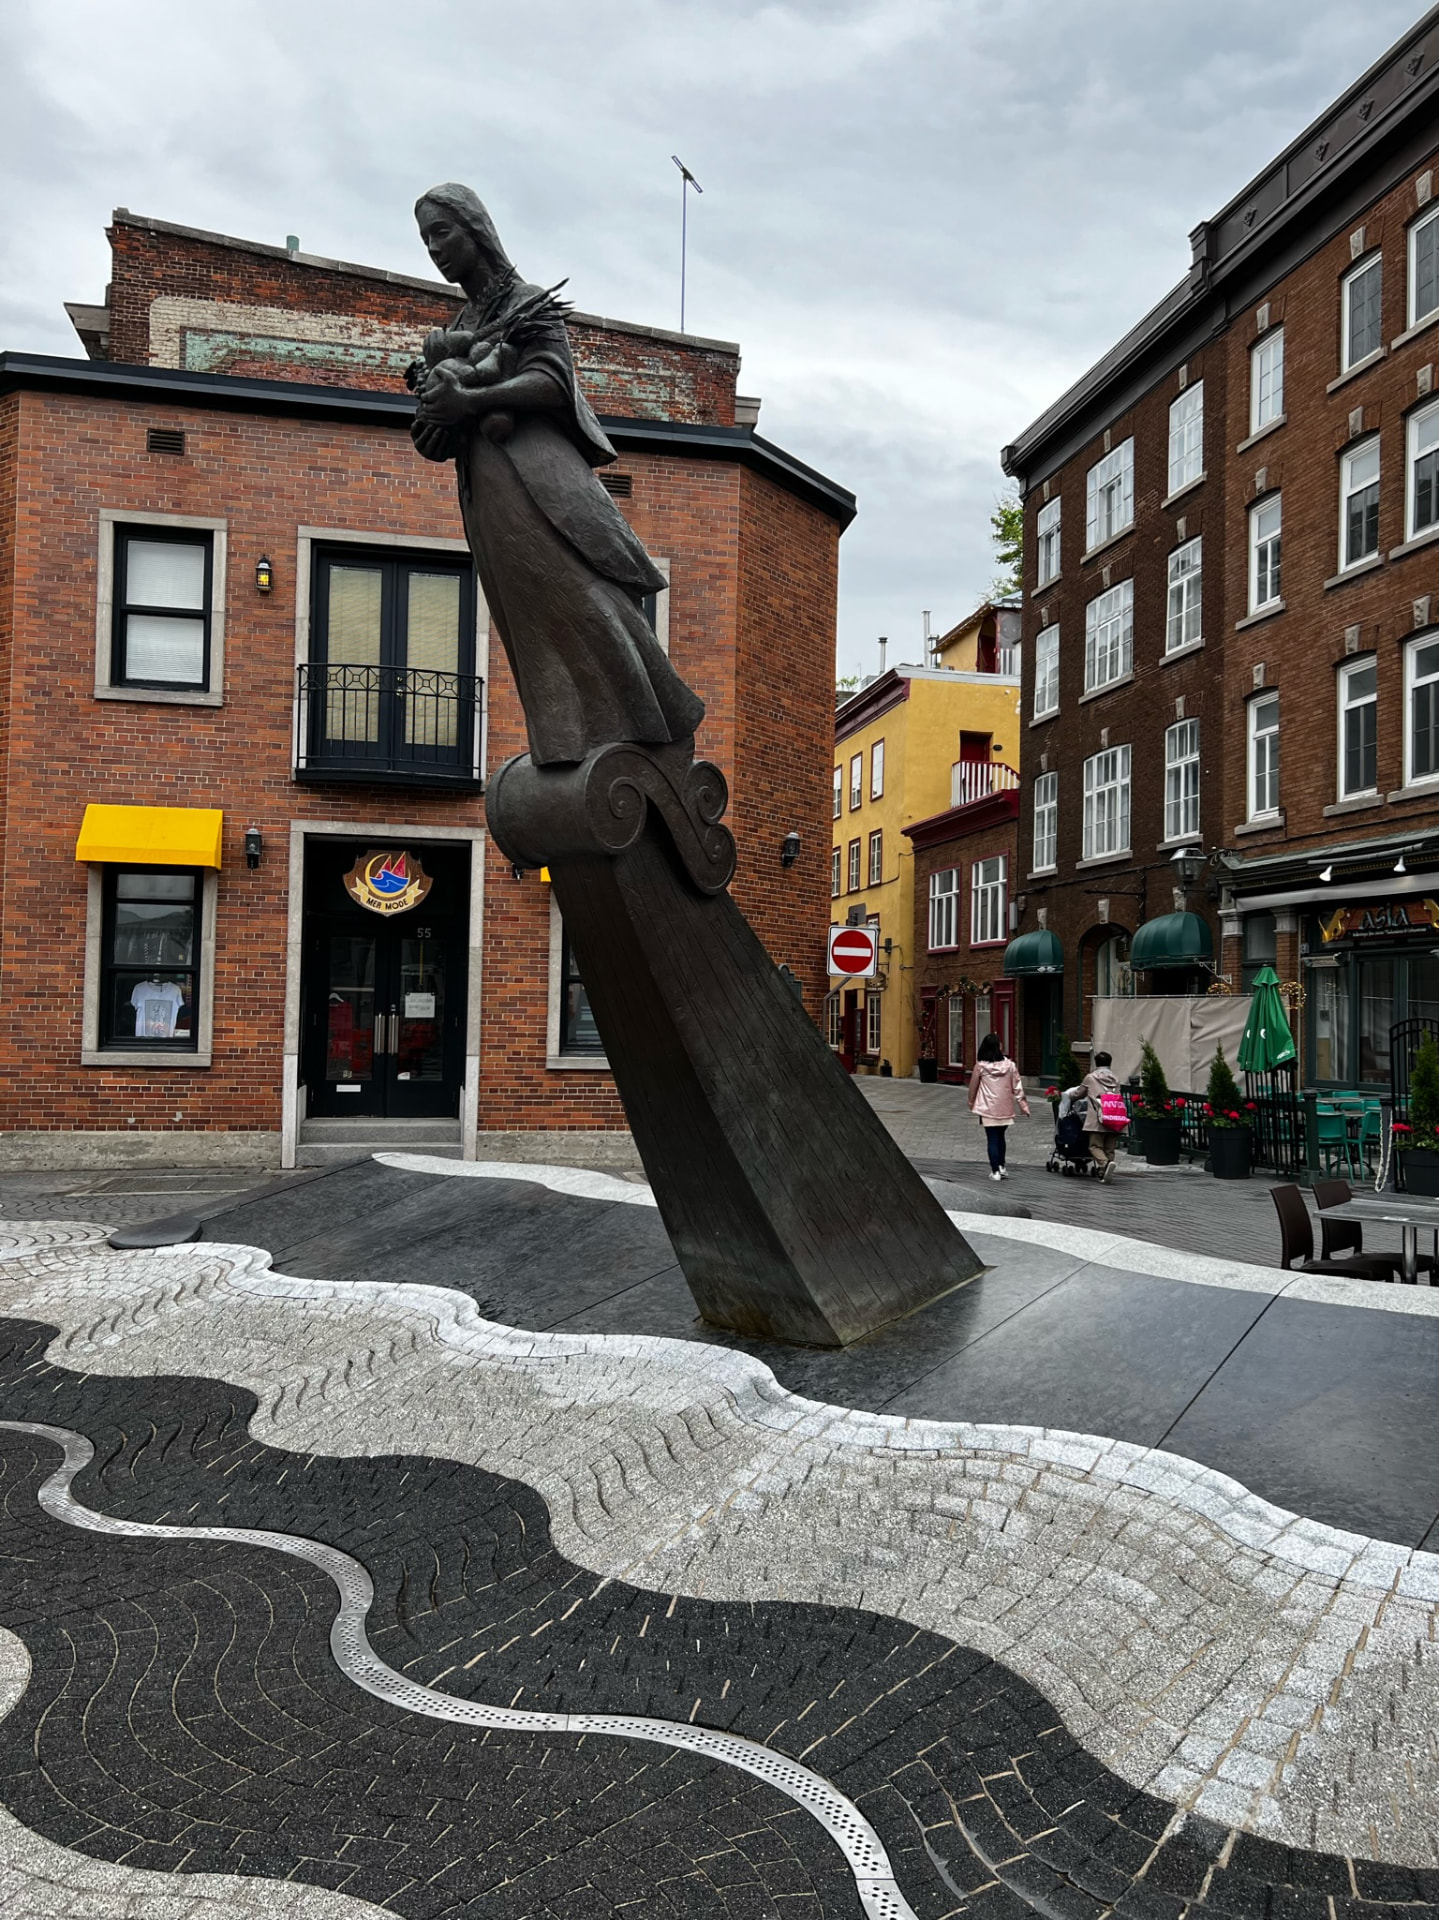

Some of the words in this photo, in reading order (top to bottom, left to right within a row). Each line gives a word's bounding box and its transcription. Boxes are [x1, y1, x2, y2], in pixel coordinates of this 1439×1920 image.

[366, 898, 382, 910] MER
[385, 898, 409, 910] MODE
[416, 927, 432, 939] 55
